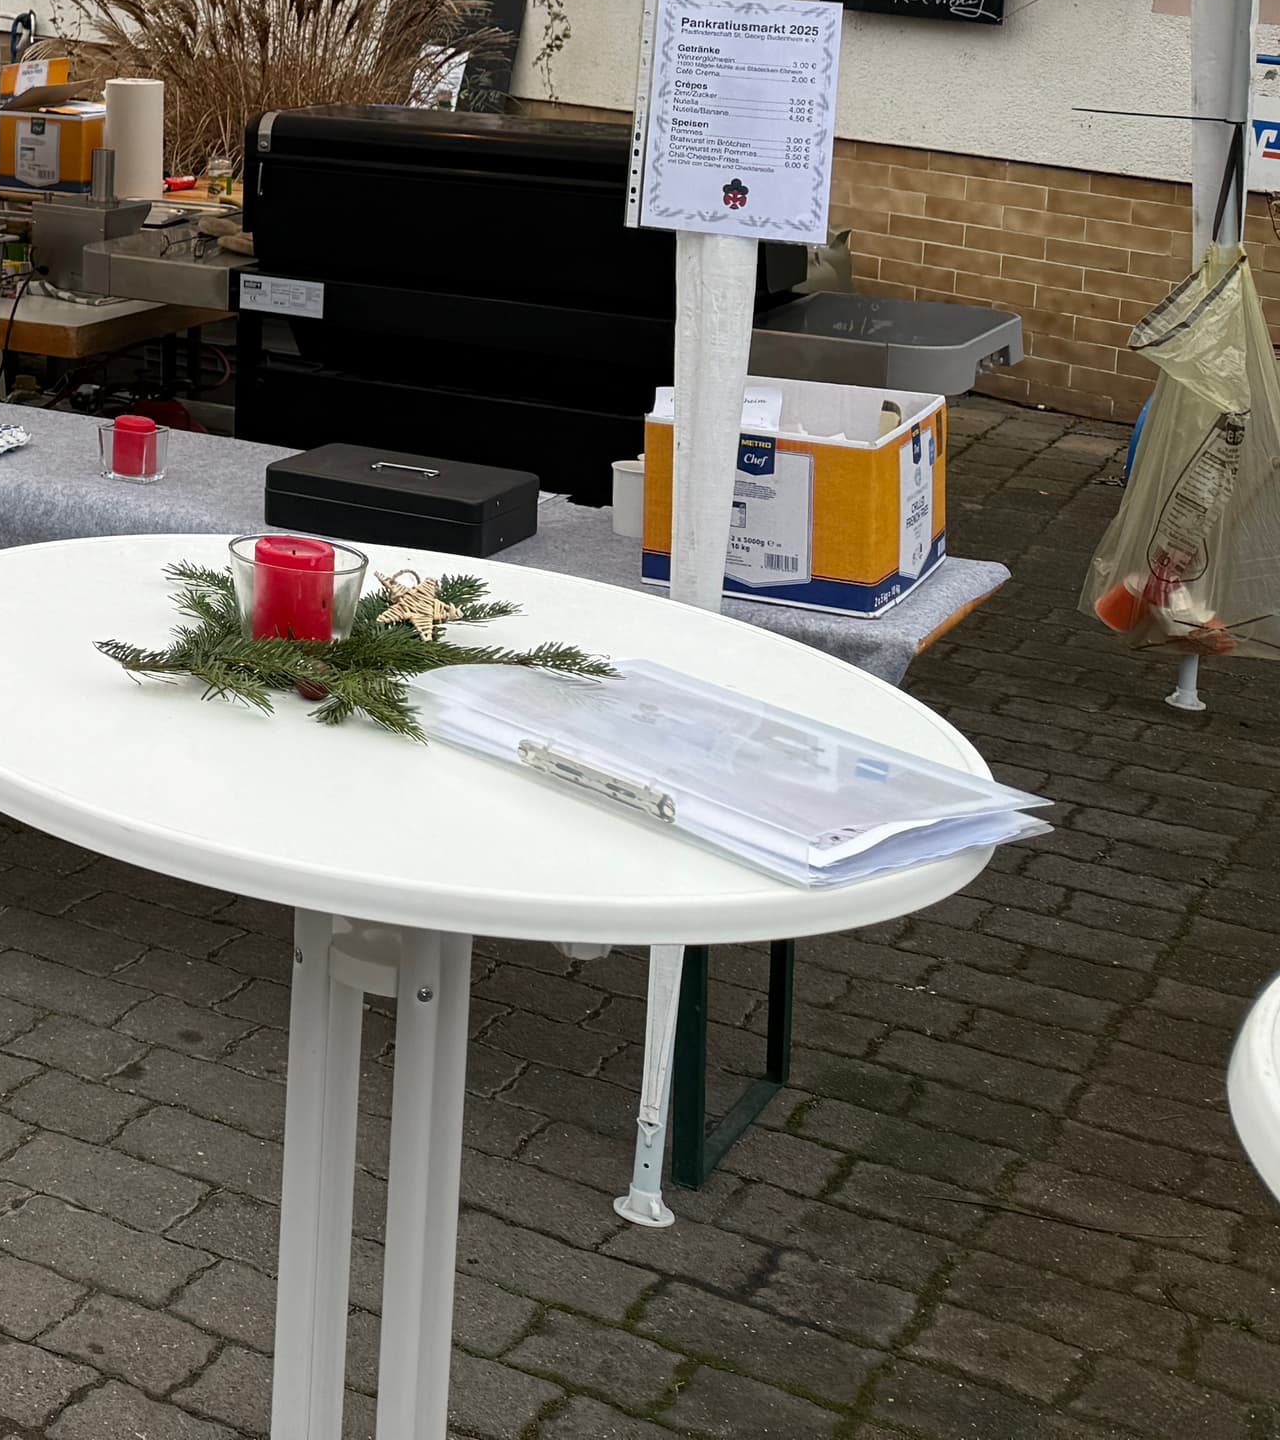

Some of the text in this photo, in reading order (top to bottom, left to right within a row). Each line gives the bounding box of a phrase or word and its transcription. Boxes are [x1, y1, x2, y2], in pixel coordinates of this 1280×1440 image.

[681, 17, 819, 36] Pankratiusmarkt 2025
[677, 44, 721, 54] Getränke
[671, 117, 709, 128] Speisen
[671, 126, 704, 136] Pommes
[670, 134, 706, 144] Bratwurst
[717, 139, 751, 148] Brötchen
[669, 142, 709, 152] Currywurst
[724, 147, 757, 157] Pommes
[741, 439, 772, 449] METRO
[743, 453, 769, 468] Chef
[743, 536, 765, 547] 5000g
[741, 544, 750, 553] kg
